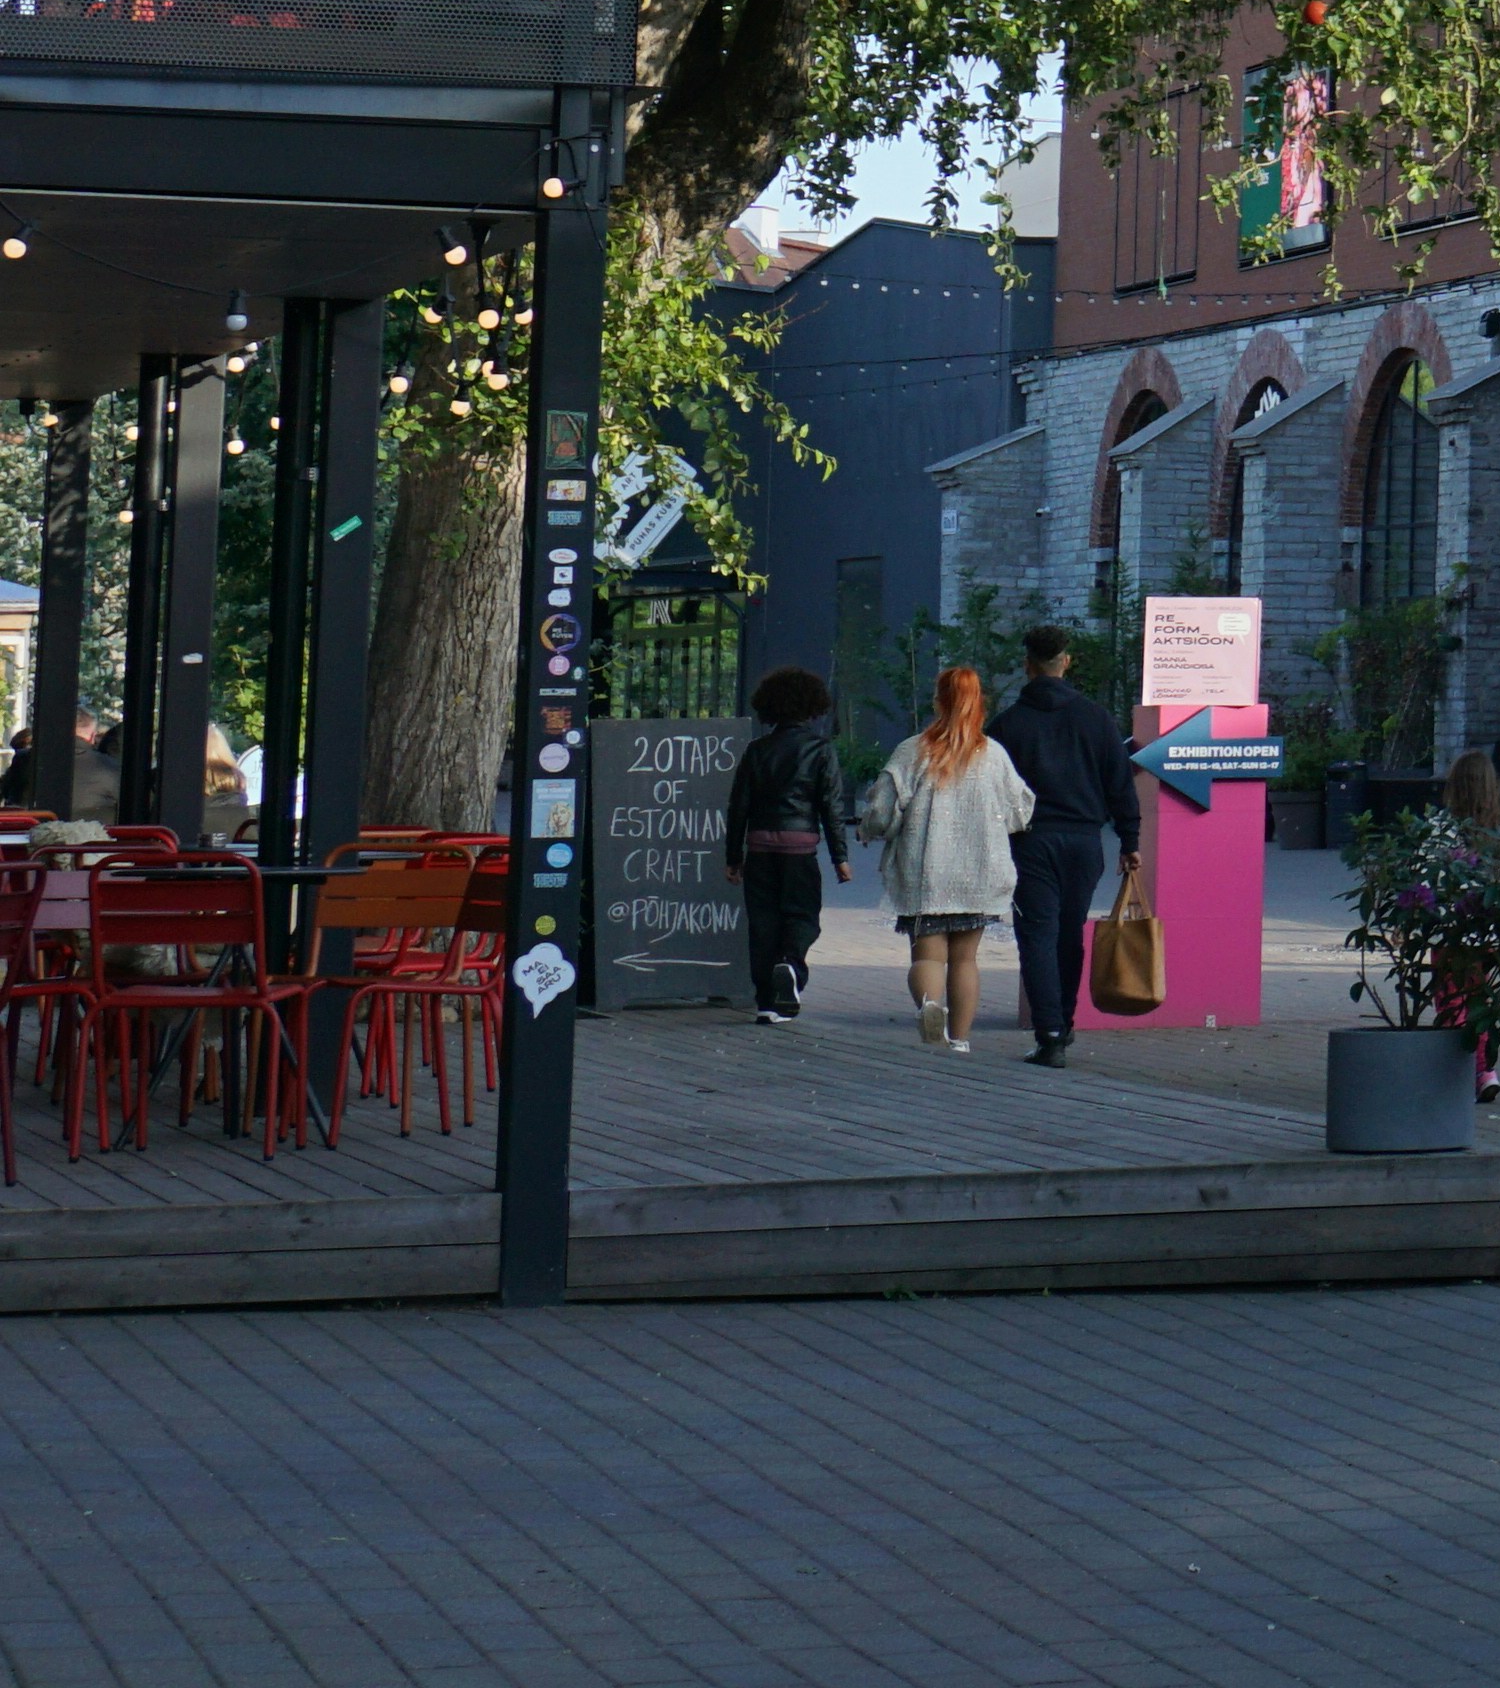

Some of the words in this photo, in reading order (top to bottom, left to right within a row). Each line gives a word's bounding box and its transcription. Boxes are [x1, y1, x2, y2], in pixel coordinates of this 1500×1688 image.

[629, 522, 656, 551] PUHAS
[1168, 746, 1242, 758] EXHIBITION
[1243, 746, 1279, 757] OPEN
[653, 779, 688, 804] OF
[610, 806, 727, 842] ESTONIAN
[623, 848, 712, 883] CRAFT
[522, 960, 541, 976] MA
[536, 966, 562, 985] SAA
[537, 964, 549, 975] EI
[537, 974, 561, 994] ARU
